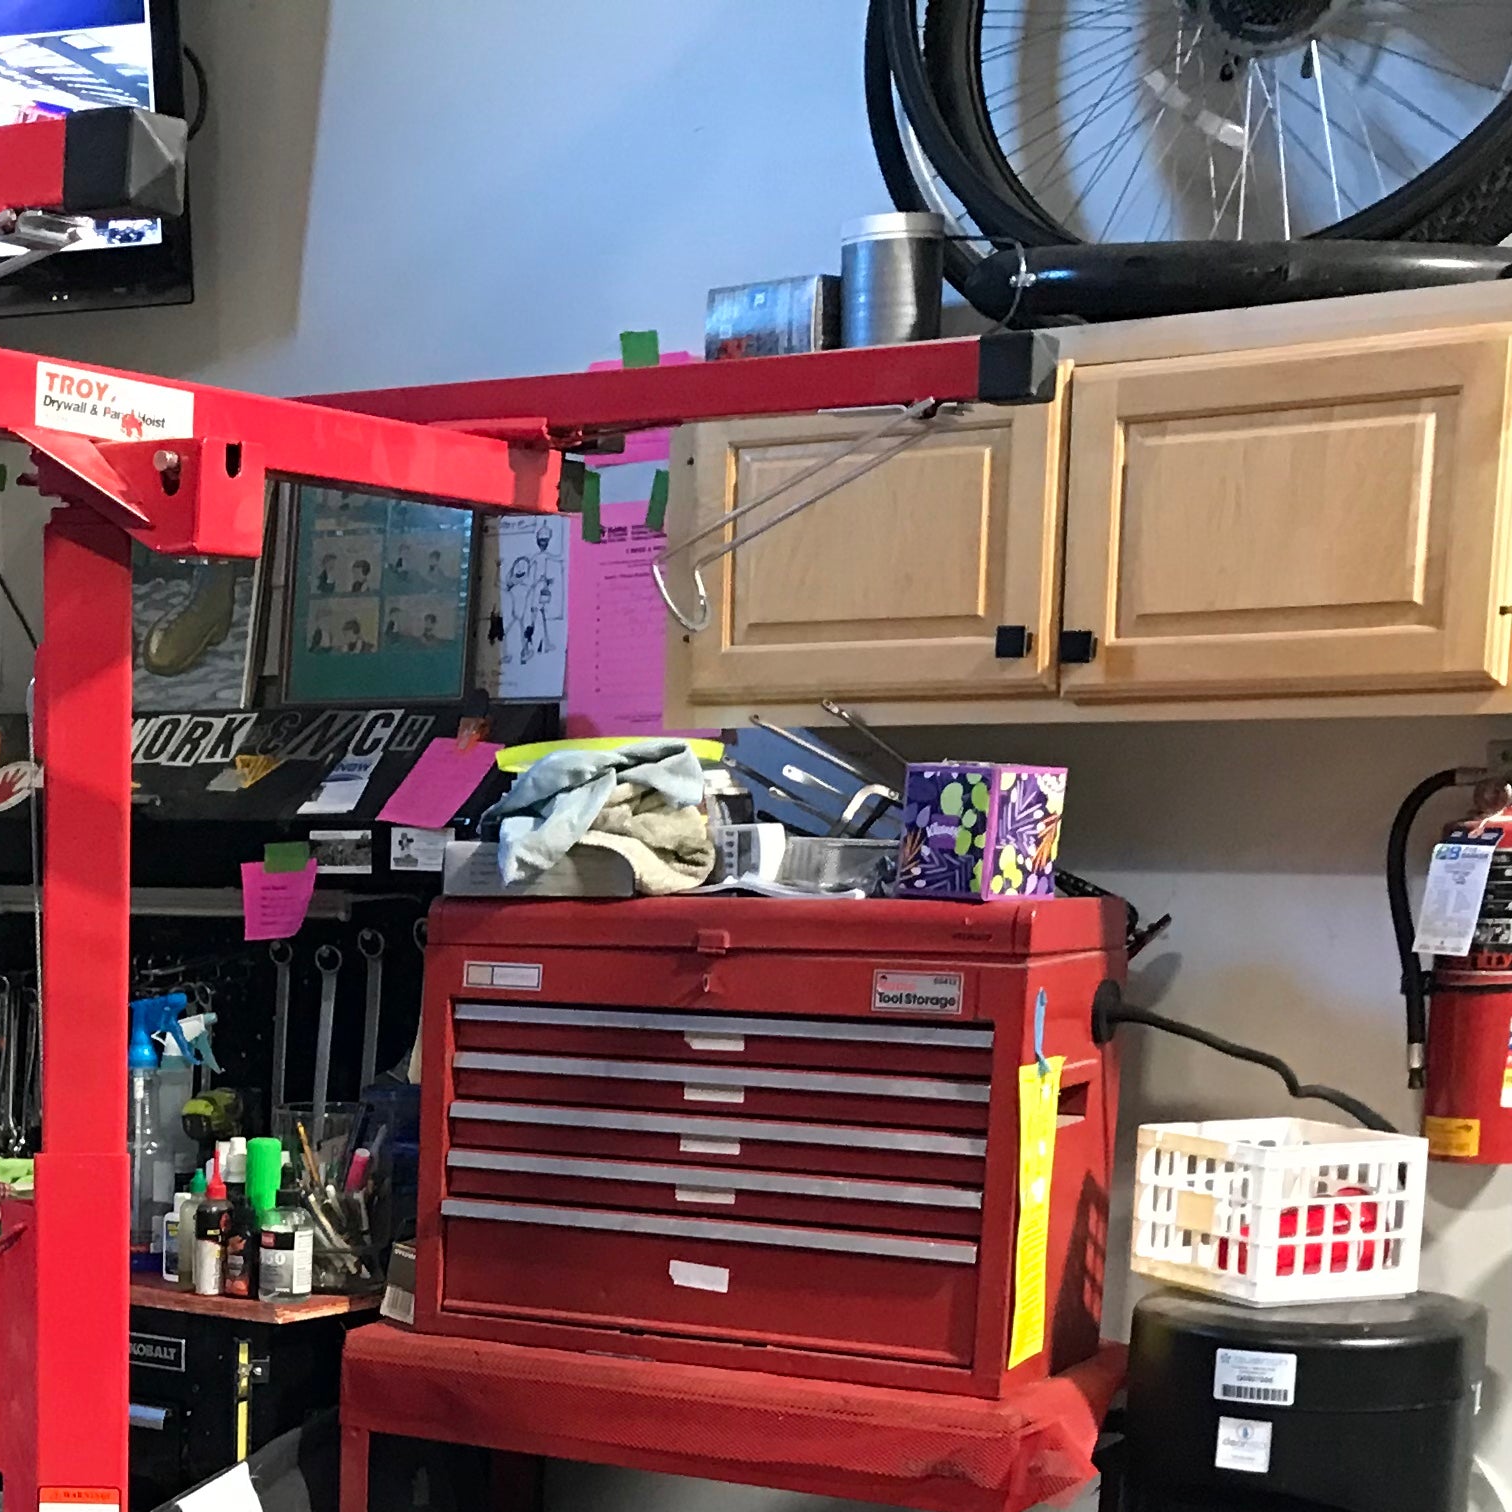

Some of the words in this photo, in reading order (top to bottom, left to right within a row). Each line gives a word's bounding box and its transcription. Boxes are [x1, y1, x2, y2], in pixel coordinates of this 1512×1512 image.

[45, 372, 109, 401] TROY
[43, 394, 87, 414] Drywall
[90, 404, 98, 416] &
[877, 991, 903, 1004] Tool
[905, 992, 957, 1010] Storage
[129, 1342, 177, 1360] KOBALT
